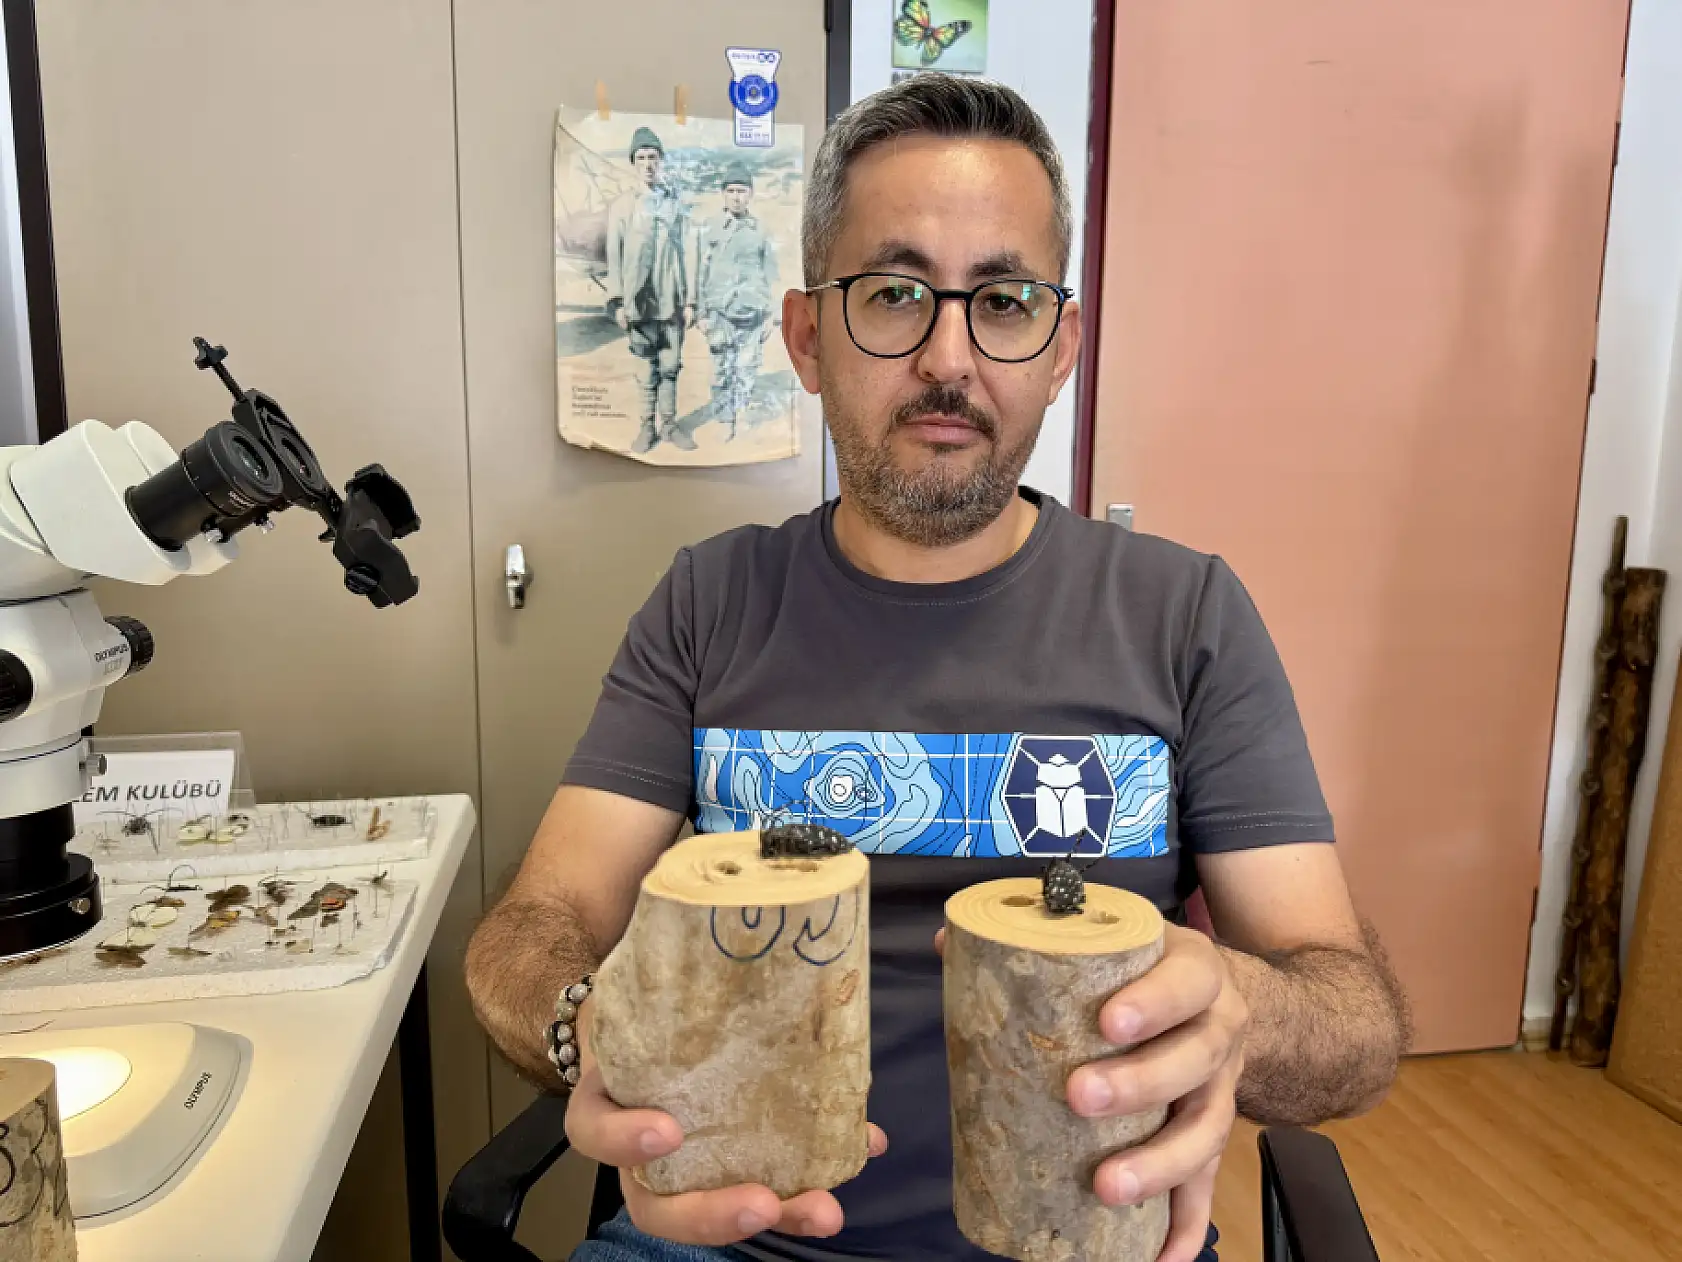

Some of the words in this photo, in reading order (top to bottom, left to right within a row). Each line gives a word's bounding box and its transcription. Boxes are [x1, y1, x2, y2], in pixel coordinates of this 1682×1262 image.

[72, 785, 119, 803] EM
[126, 779, 222, 801] KULÜBÜ
[183, 1071, 213, 1110] OLYMPUS
